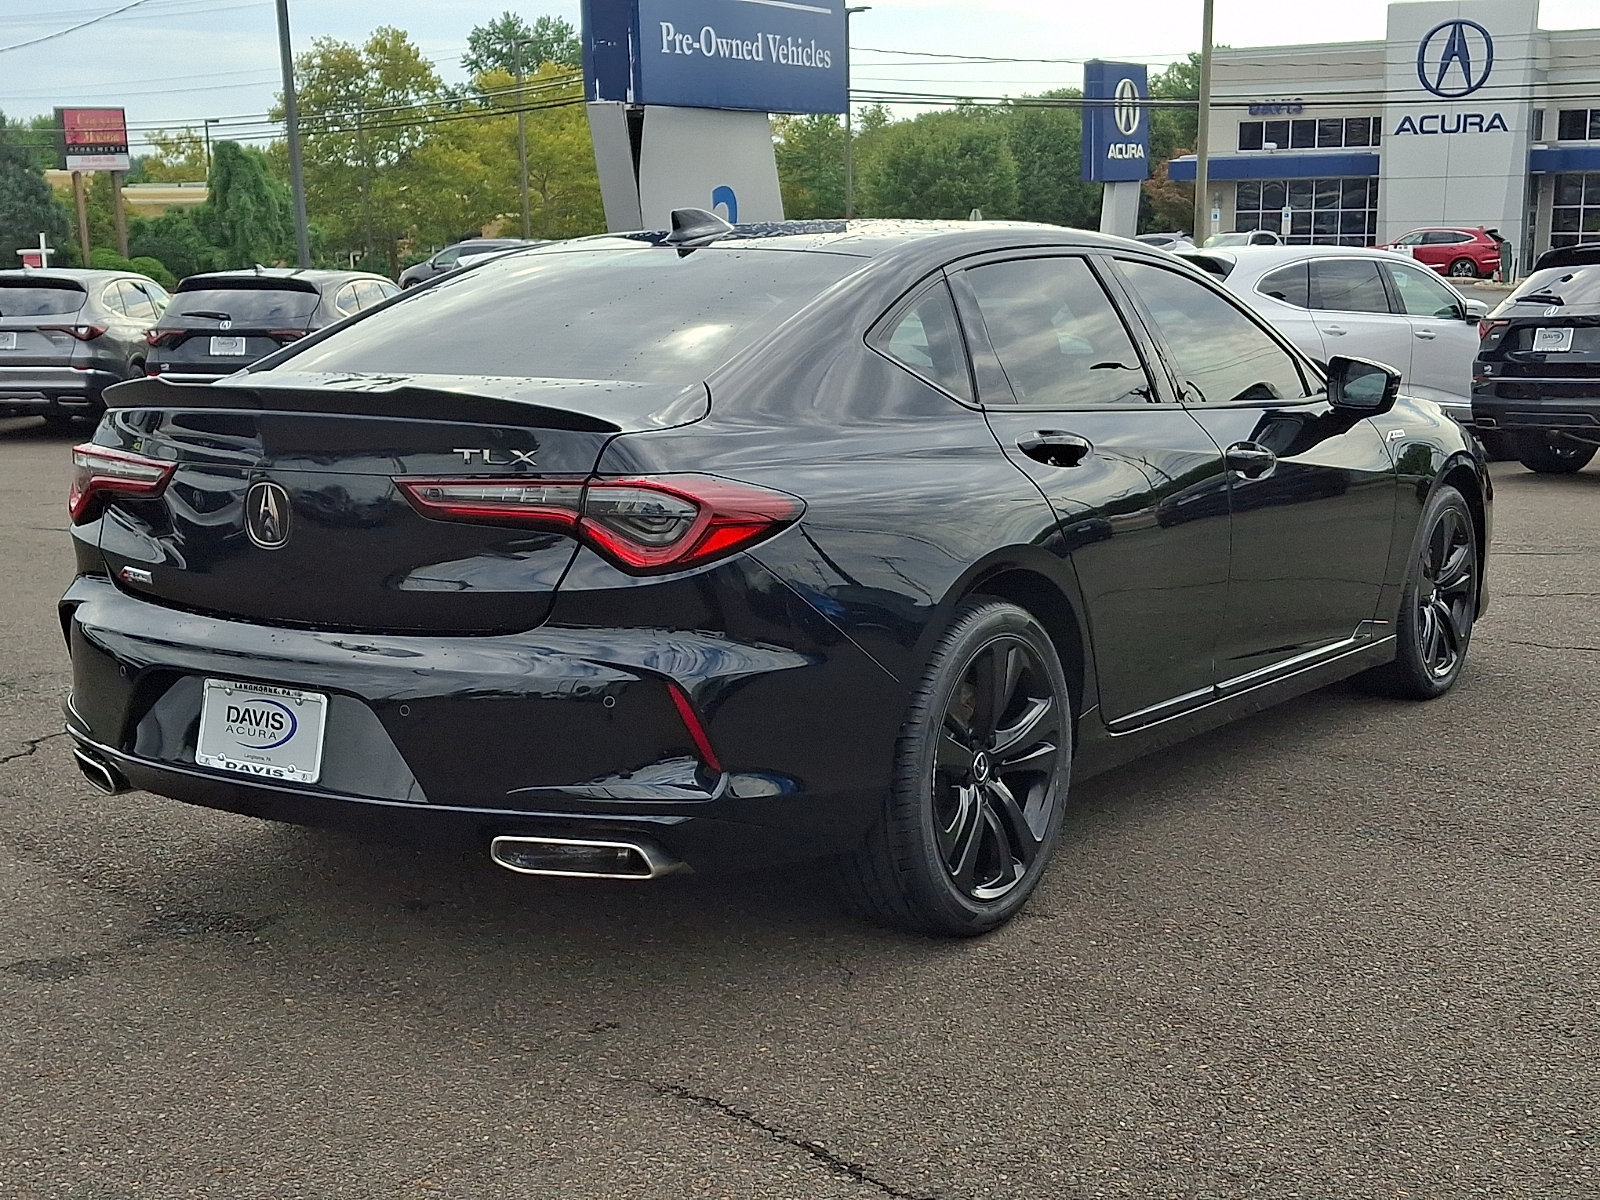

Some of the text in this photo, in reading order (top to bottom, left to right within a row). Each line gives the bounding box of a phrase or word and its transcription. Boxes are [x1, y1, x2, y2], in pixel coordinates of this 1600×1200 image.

[659, 21, 832, 69] Pre-Owned Vehicles
[1394, 112, 1509, 136] ACURA
[1107, 143, 1145, 159] ACURA
[452, 448, 539, 466] TLX
[226, 705, 285, 731] DAVIS
[225, 725, 278, 741] ACURA
[225, 761, 284, 778] DAVIS
